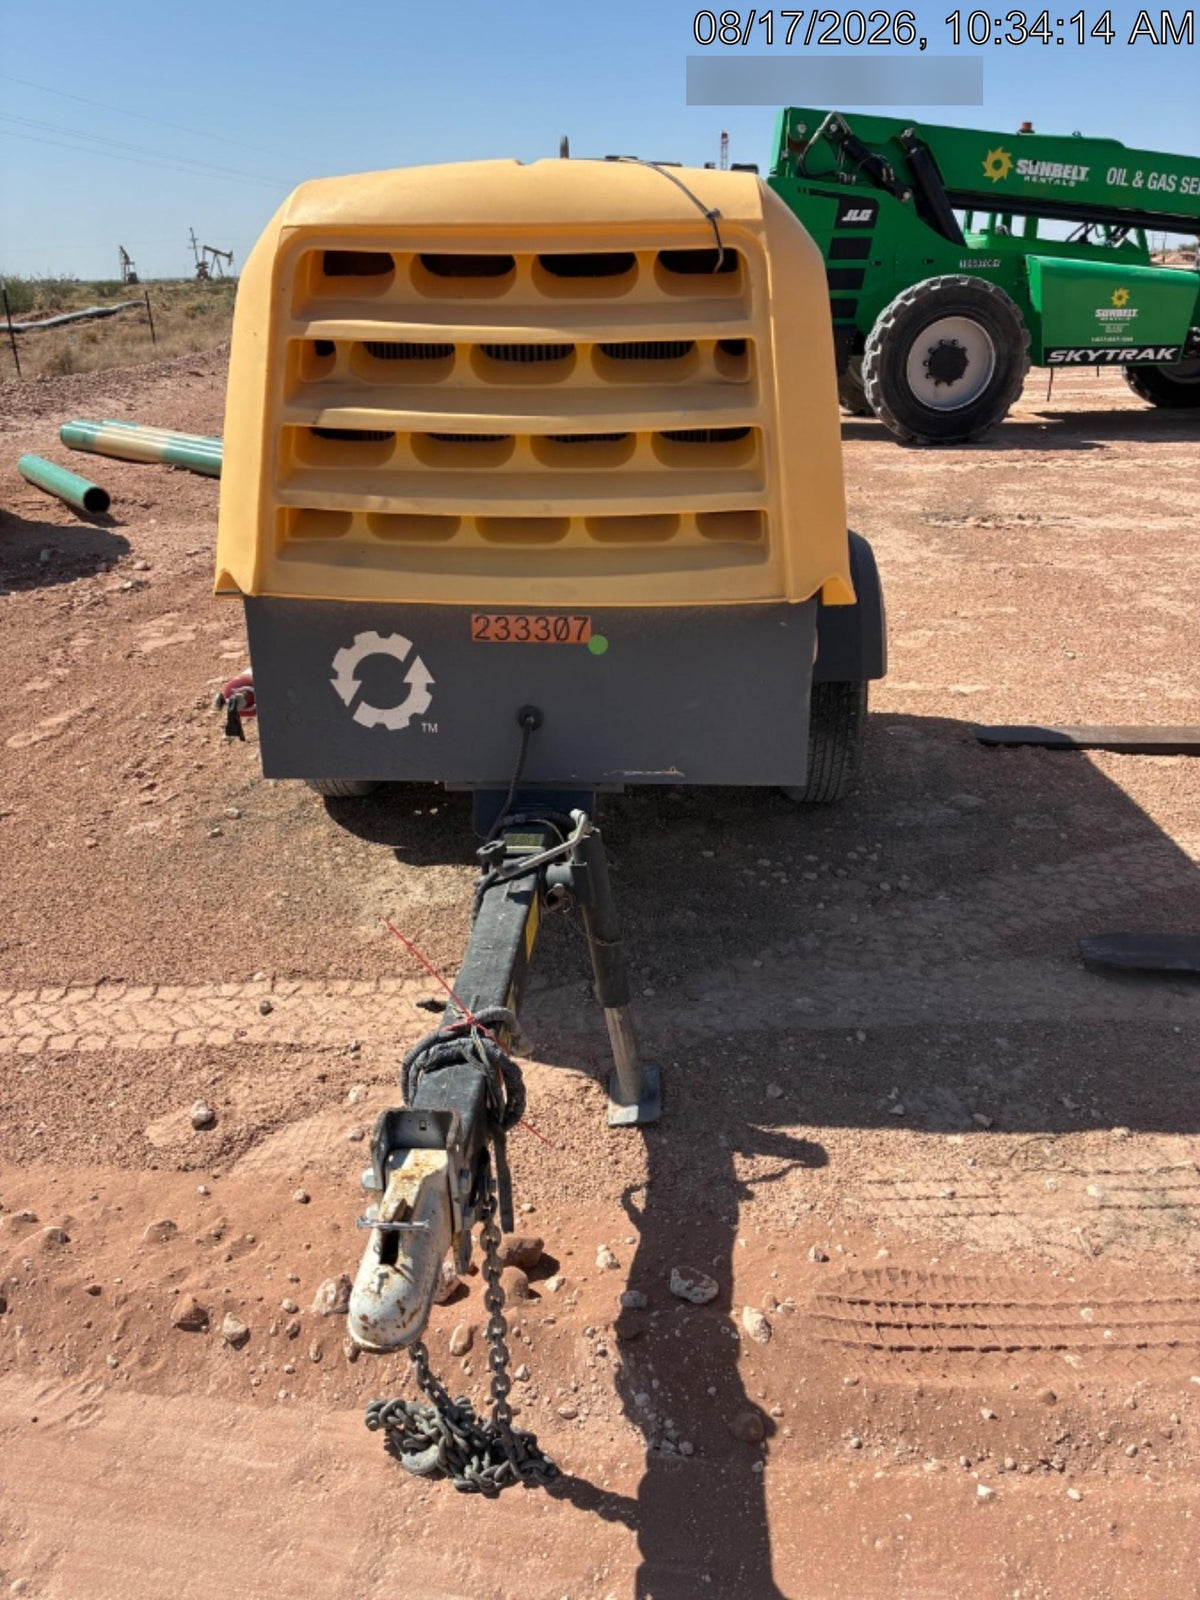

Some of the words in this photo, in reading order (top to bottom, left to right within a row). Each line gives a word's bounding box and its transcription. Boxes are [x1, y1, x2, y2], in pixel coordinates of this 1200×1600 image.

[1015, 158, 1091, 182] SUNBELT
[1023, 175, 1076, 188] RENTALS
[1106, 167, 1128, 187] OIL
[1132, 170, 1144, 188] &
[1147, 171, 1177, 193] GAS
[1179, 175, 1200, 196] SE
[841, 209, 874, 222] JLG
[1047, 347, 1178, 363] SKYTRAK
[473, 615, 590, 641] 233307
